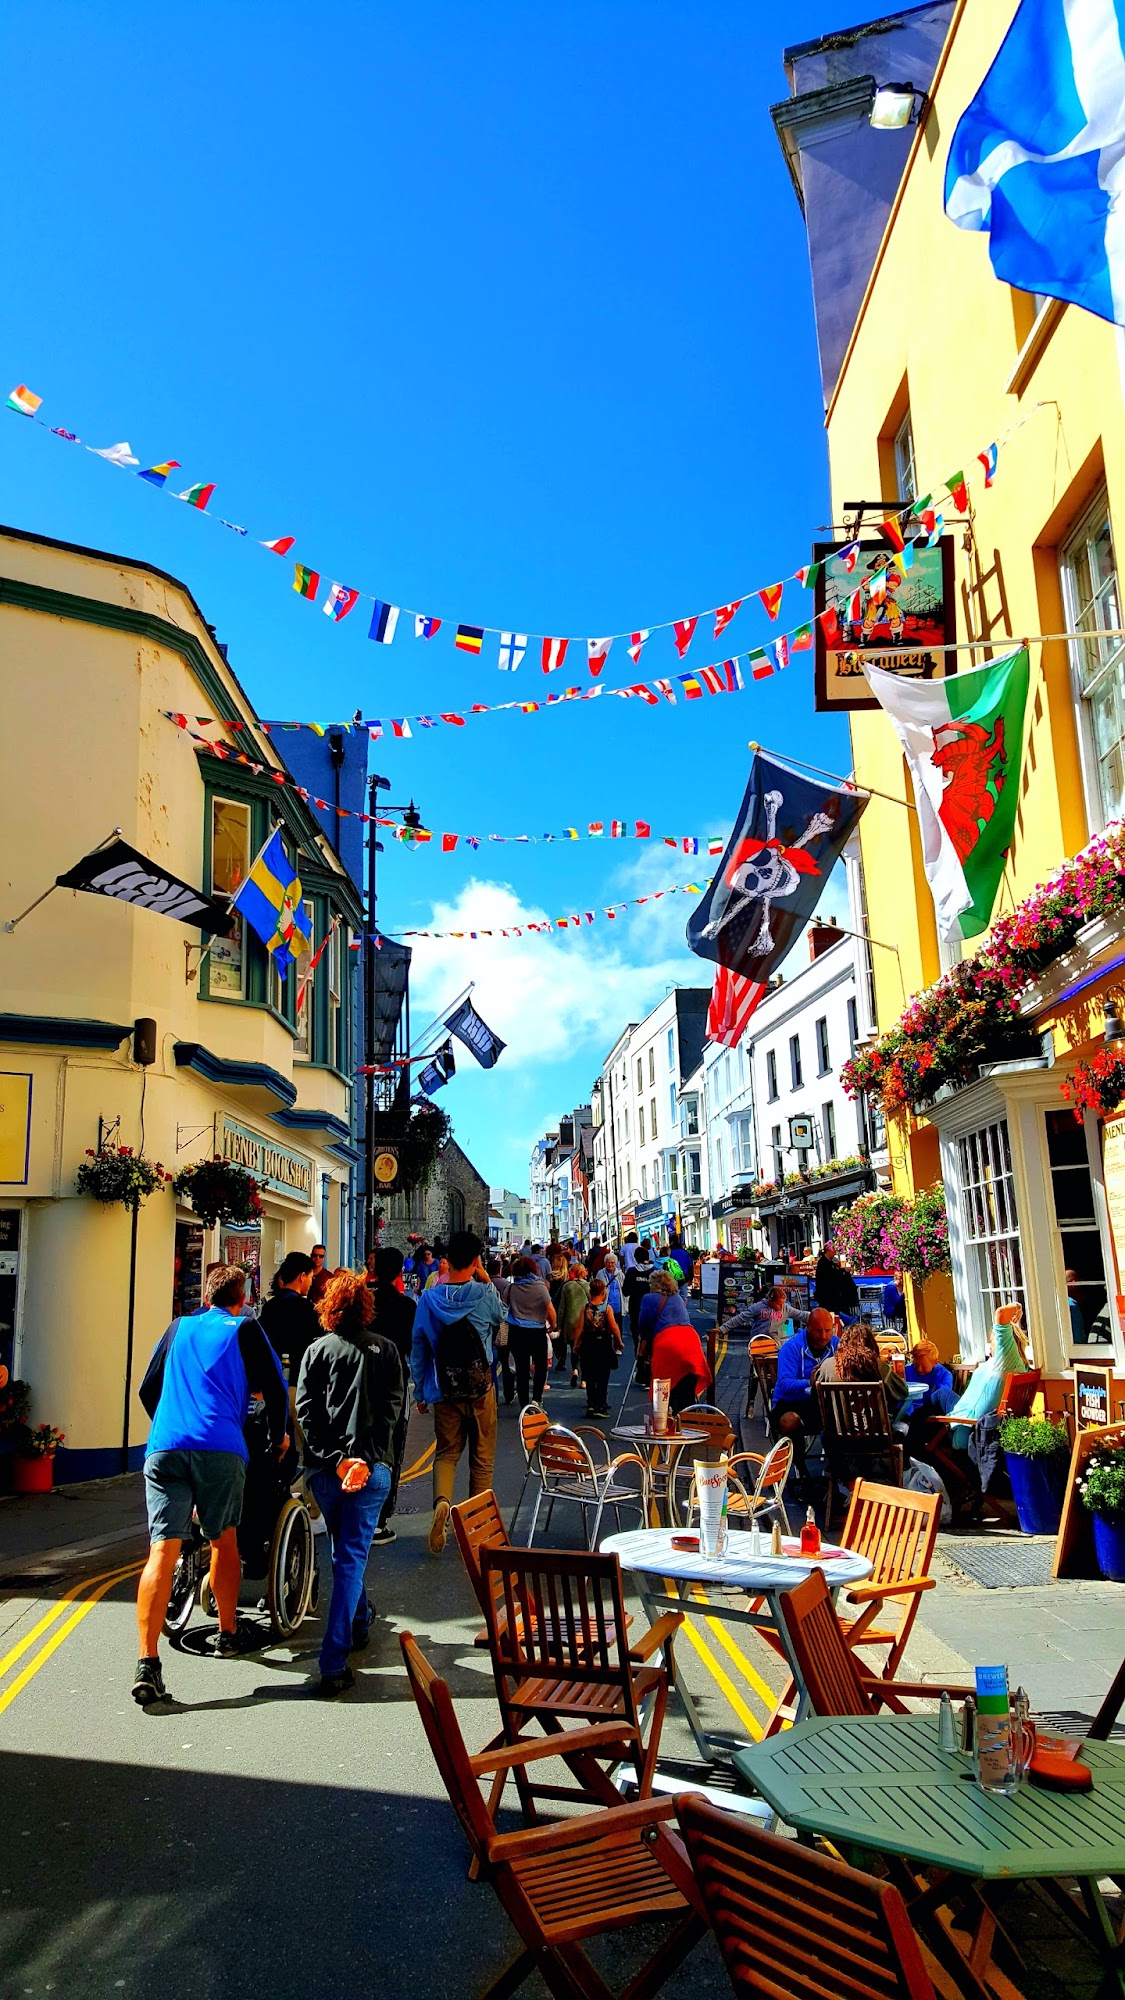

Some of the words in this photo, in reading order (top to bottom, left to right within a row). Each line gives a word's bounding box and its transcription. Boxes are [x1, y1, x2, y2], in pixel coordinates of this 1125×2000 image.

[837, 653, 926, 674] Bucaneer
[224, 1126, 262, 1172] TENBY
[262, 1147, 310, 1192] BOOKSHOP
[1086, 1395, 1100, 1408] FISH
[1081, 1406, 1106, 1422] CHOWDER
